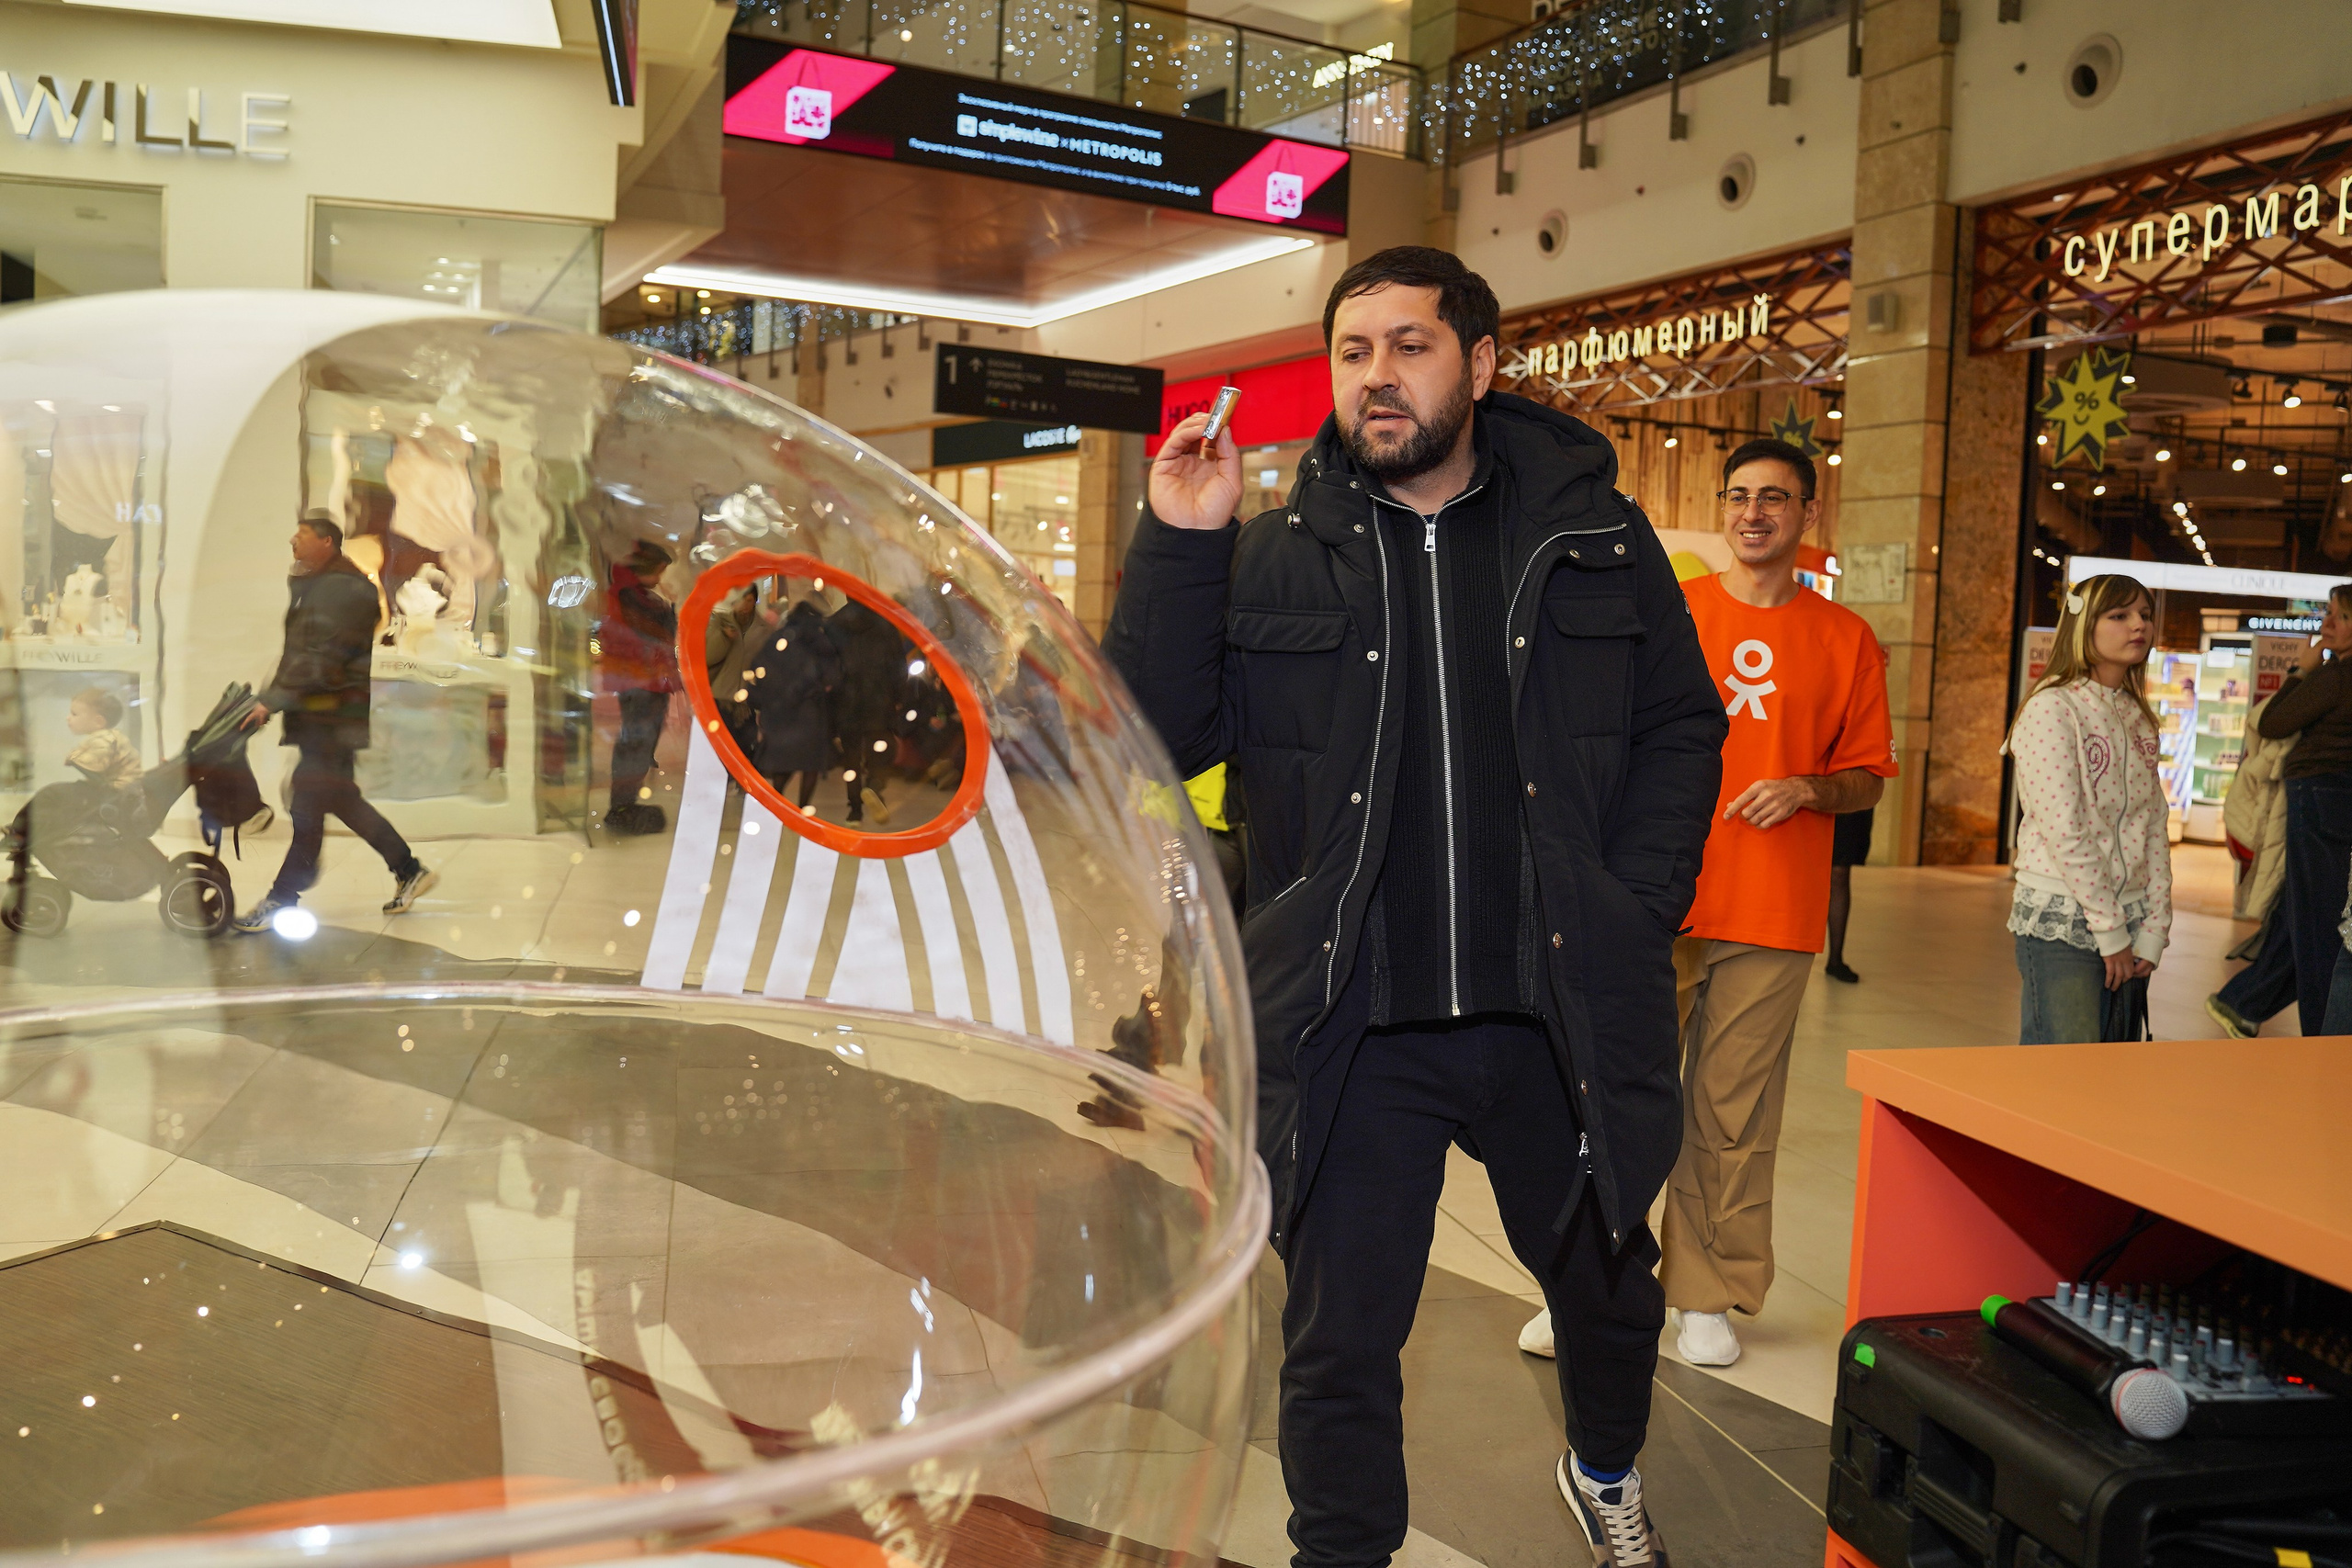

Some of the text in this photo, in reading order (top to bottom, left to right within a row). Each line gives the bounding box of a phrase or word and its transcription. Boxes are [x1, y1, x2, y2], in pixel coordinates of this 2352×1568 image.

[1069, 137, 1162, 167] METROPOLIS
[1528, 292, 1770, 379] парфюмерный
[944, 355, 958, 385] 1
[2248, 617, 2323, 632] GIVENCHY
